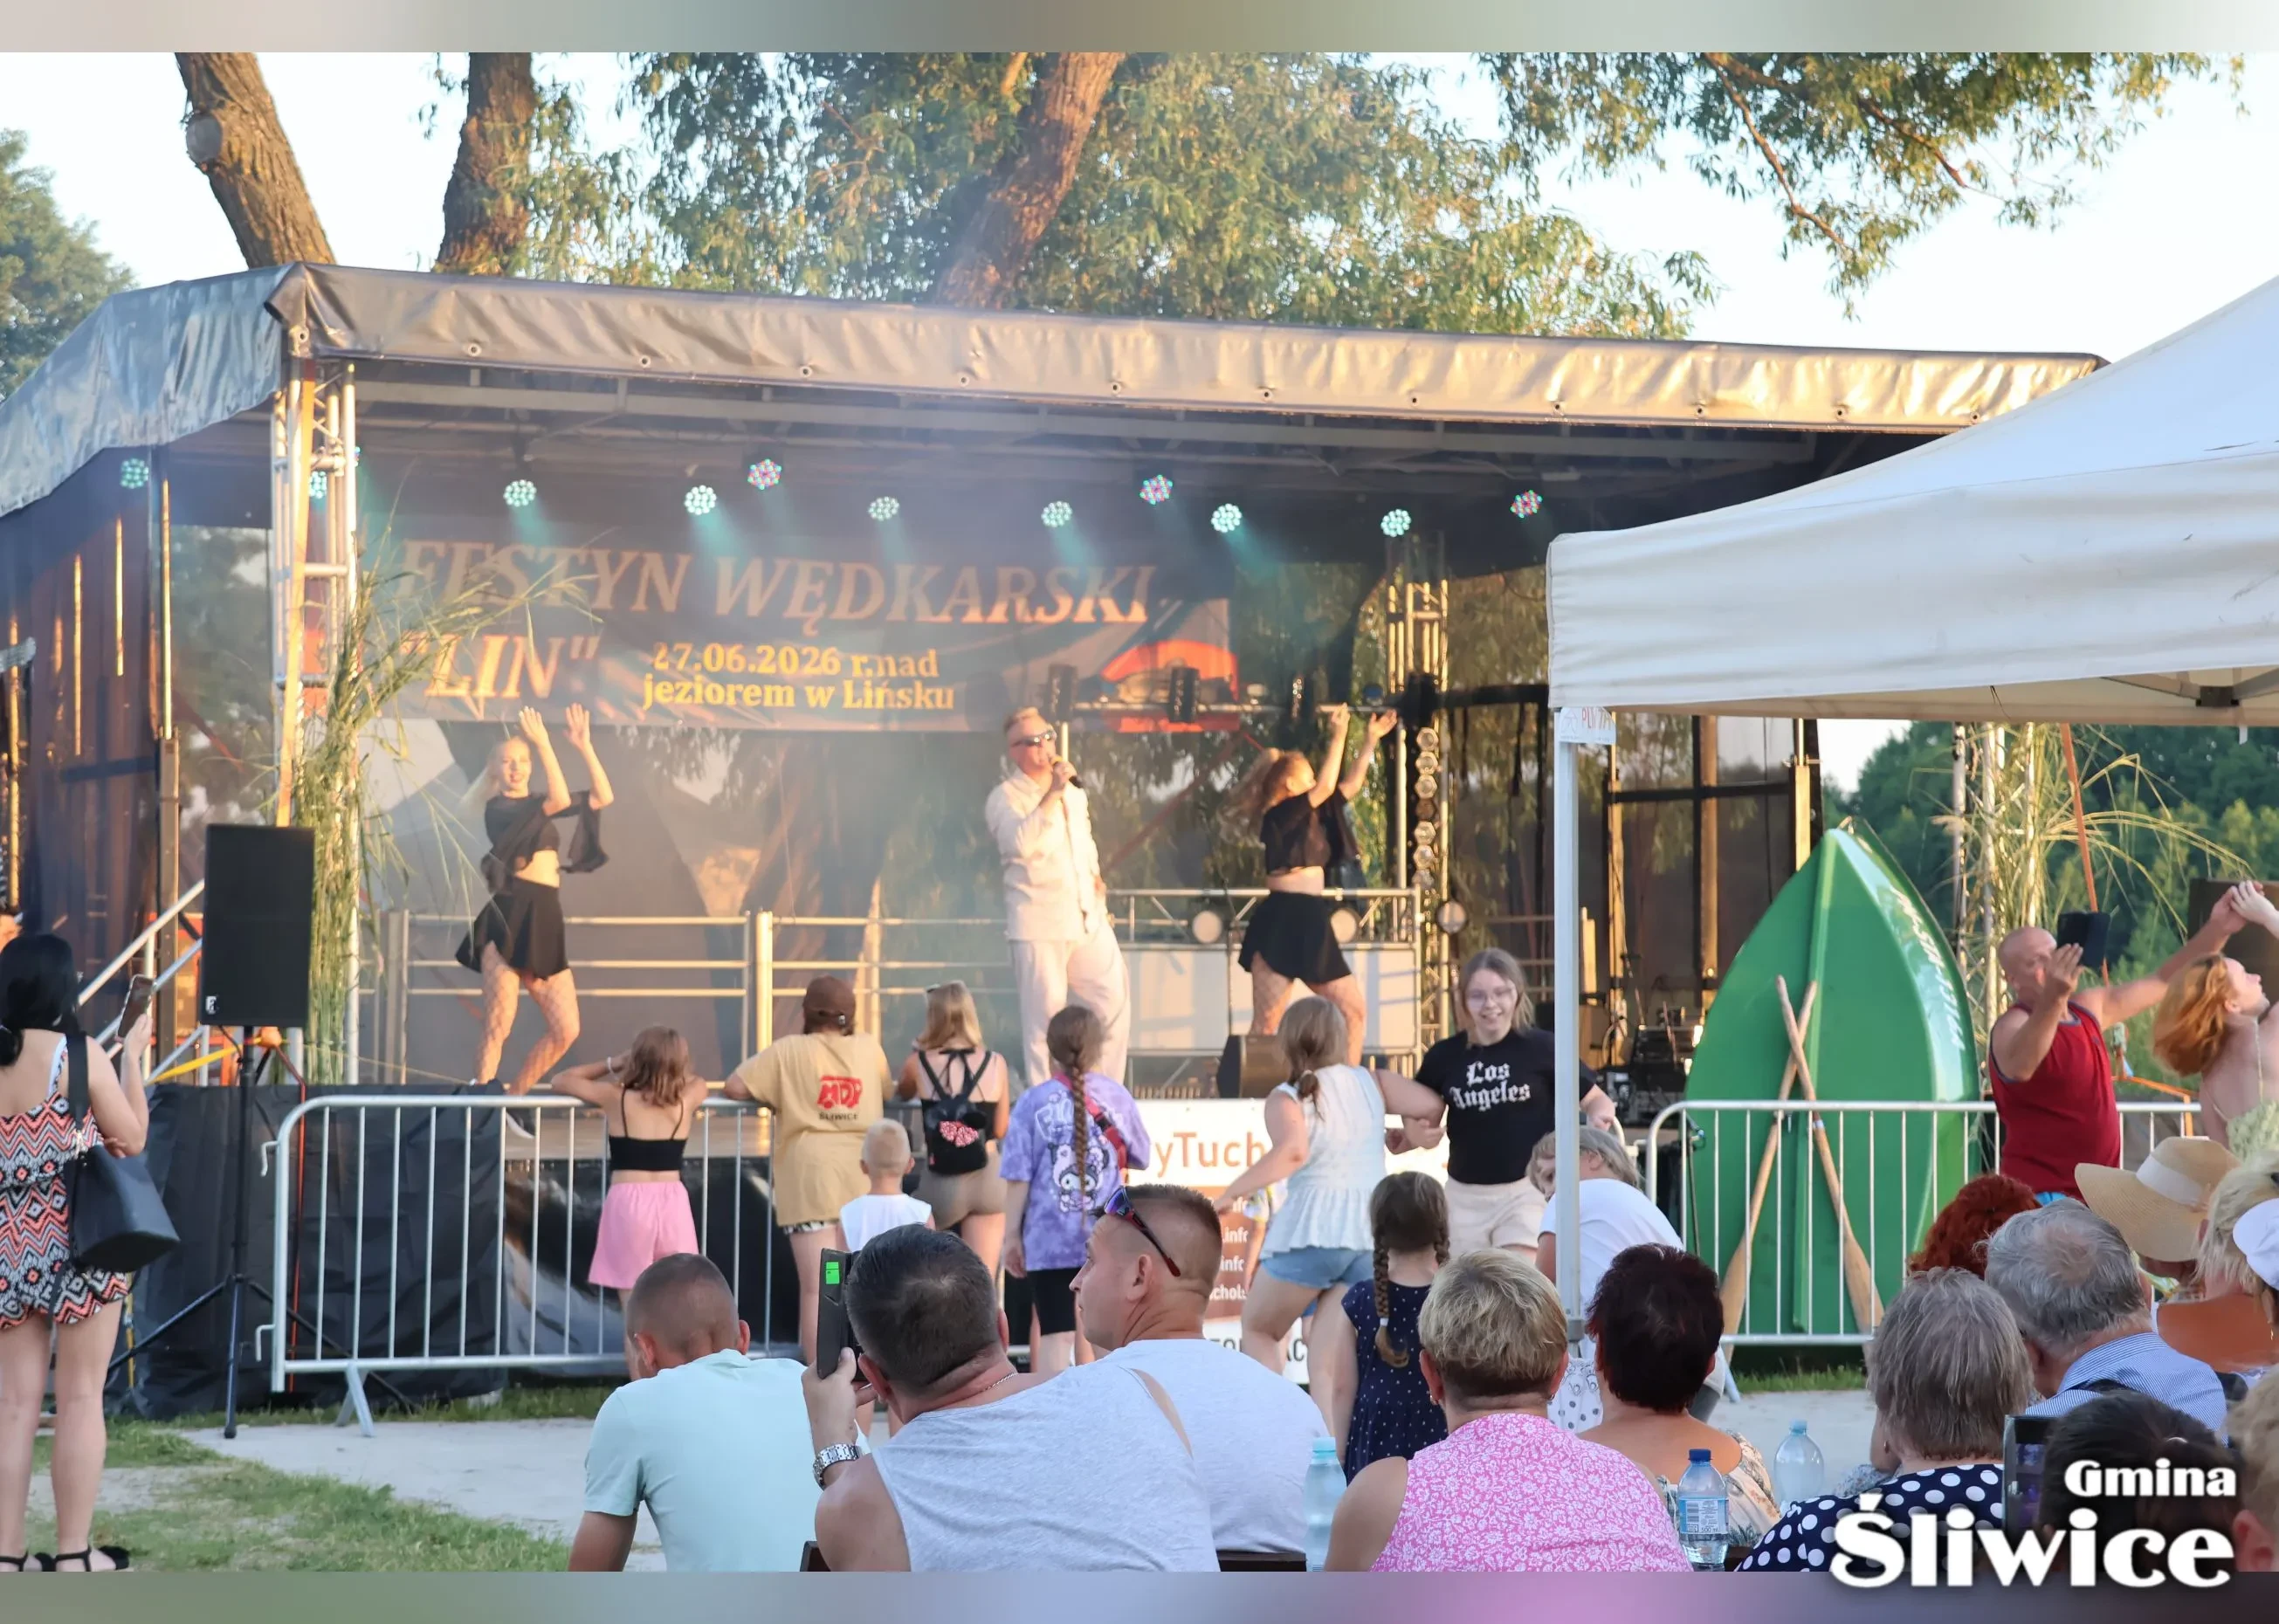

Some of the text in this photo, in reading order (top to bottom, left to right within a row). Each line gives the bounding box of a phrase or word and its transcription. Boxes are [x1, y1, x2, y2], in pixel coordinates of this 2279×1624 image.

[397, 539, 1157, 637] FESTYN WĘDKARSKI
[652, 642, 842, 676] 27.06.2026
[643, 672, 954, 711] jeziorem w Lińsku
[1466, 1060, 1511, 1087] Los
[1449, 1080, 1531, 1111] Angeles
